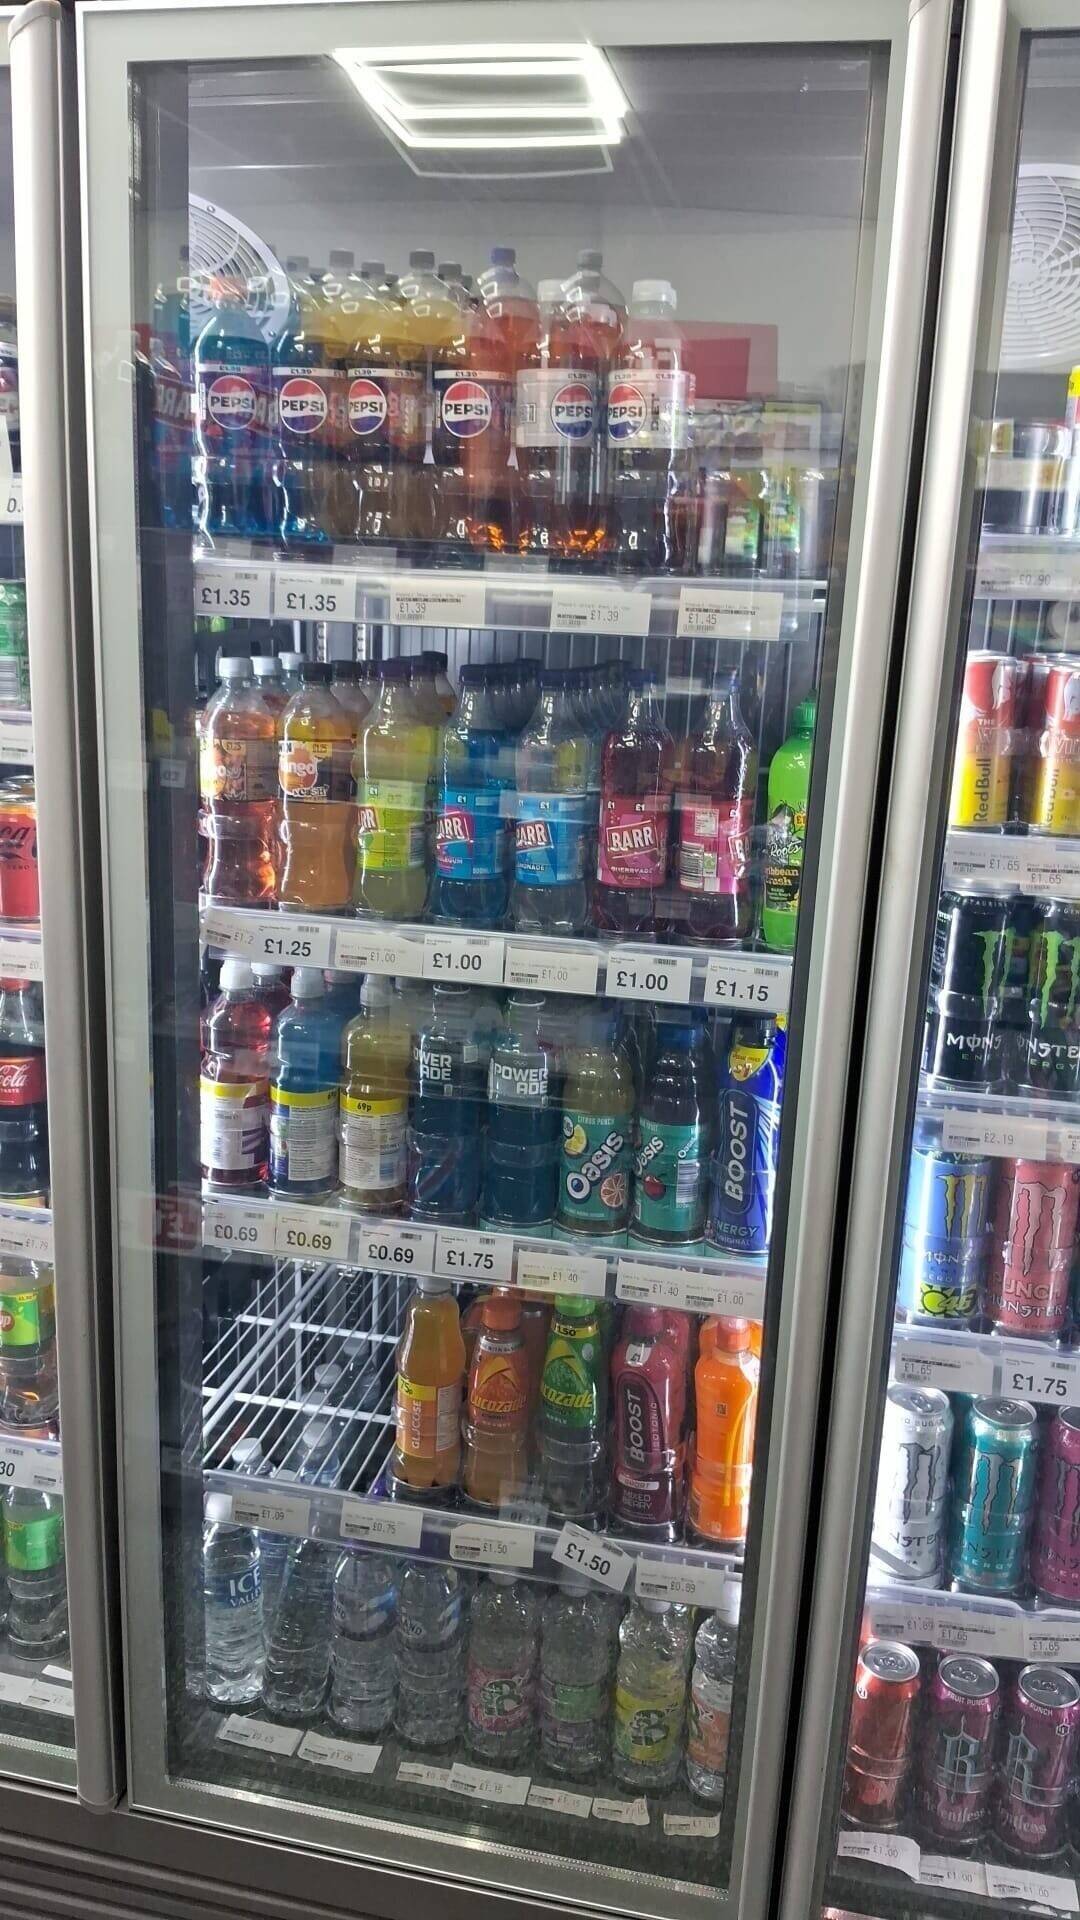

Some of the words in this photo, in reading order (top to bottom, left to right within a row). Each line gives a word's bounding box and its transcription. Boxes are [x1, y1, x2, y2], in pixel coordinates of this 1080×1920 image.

[210, 395, 255, 411] PEPSI
[281, 400, 325, 413] PEPSI
[350, 401, 384, 414] PEPSI
[444, 403, 489, 416] PEPSI
[608, 404, 643, 418] PEPSI
[201, 587, 251, 606] £1.35
[286, 592, 337, 612] £1.35
[399, 602, 426, 614] £1.39
[590, 610, 619, 622] £1.39
[688, 613, 717, 625] £1.45
[975, 758, 991, 790] Bull
[457, 795, 467, 803] £1
[635, 803, 645, 811] £1
[974, 791, 989, 823] Red
[611, 826, 654, 851] BARR
[770, 839, 802, 857] Roots
[989, 860, 1020, 872] £1.65
[1031, 873, 1062, 885] £1.65
[234, 932, 254, 945] £1.2
[264, 938, 312, 957] £1.25
[370, 951, 396, 964] £1.00
[432, 952, 482, 971] £1.00
[541, 969, 569, 982] £1.00
[616, 970, 669, 991] £1.00
[715, 979, 770, 1002] £1.15
[414, 1047, 452, 1068] OWER
[494, 1062, 549, 1081] POWER
[516, 1080, 549, 1096] ADE
[356, 1102, 372, 1112] 69p
[984, 1131, 1014, 1145] £2.19
[724, 1100, 748, 1202] BOOST
[566, 1131, 624, 1199] Oasis
[214, 1224, 258, 1242] £0.69
[286, 1230, 332, 1250] £0.69
[367, 1244, 414, 1264] £0.69
[447, 1250, 495, 1270] £1.75
[552, 1271, 578, 1283] £1.40
[652, 1283, 679, 1297] £1.40
[716, 1294, 744, 1306] £1.00
[999, 1300, 1064, 1318] ONSTER
[903, 1362, 932, 1375] £1.65
[1012, 1373, 1068, 1397] £1.75
[411, 1399, 422, 1449] GLUCOSE
[628, 1389, 645, 1462] BOOST
[372, 1522, 397, 1534] £0.75
[482, 1542, 508, 1554] £1.50
[563, 1542, 611, 1576] £1.50
[229, 1565, 261, 1597] ICE
[1032, 1640, 1060, 1651] £1.65
[872, 1844, 899, 1858] £1.00
